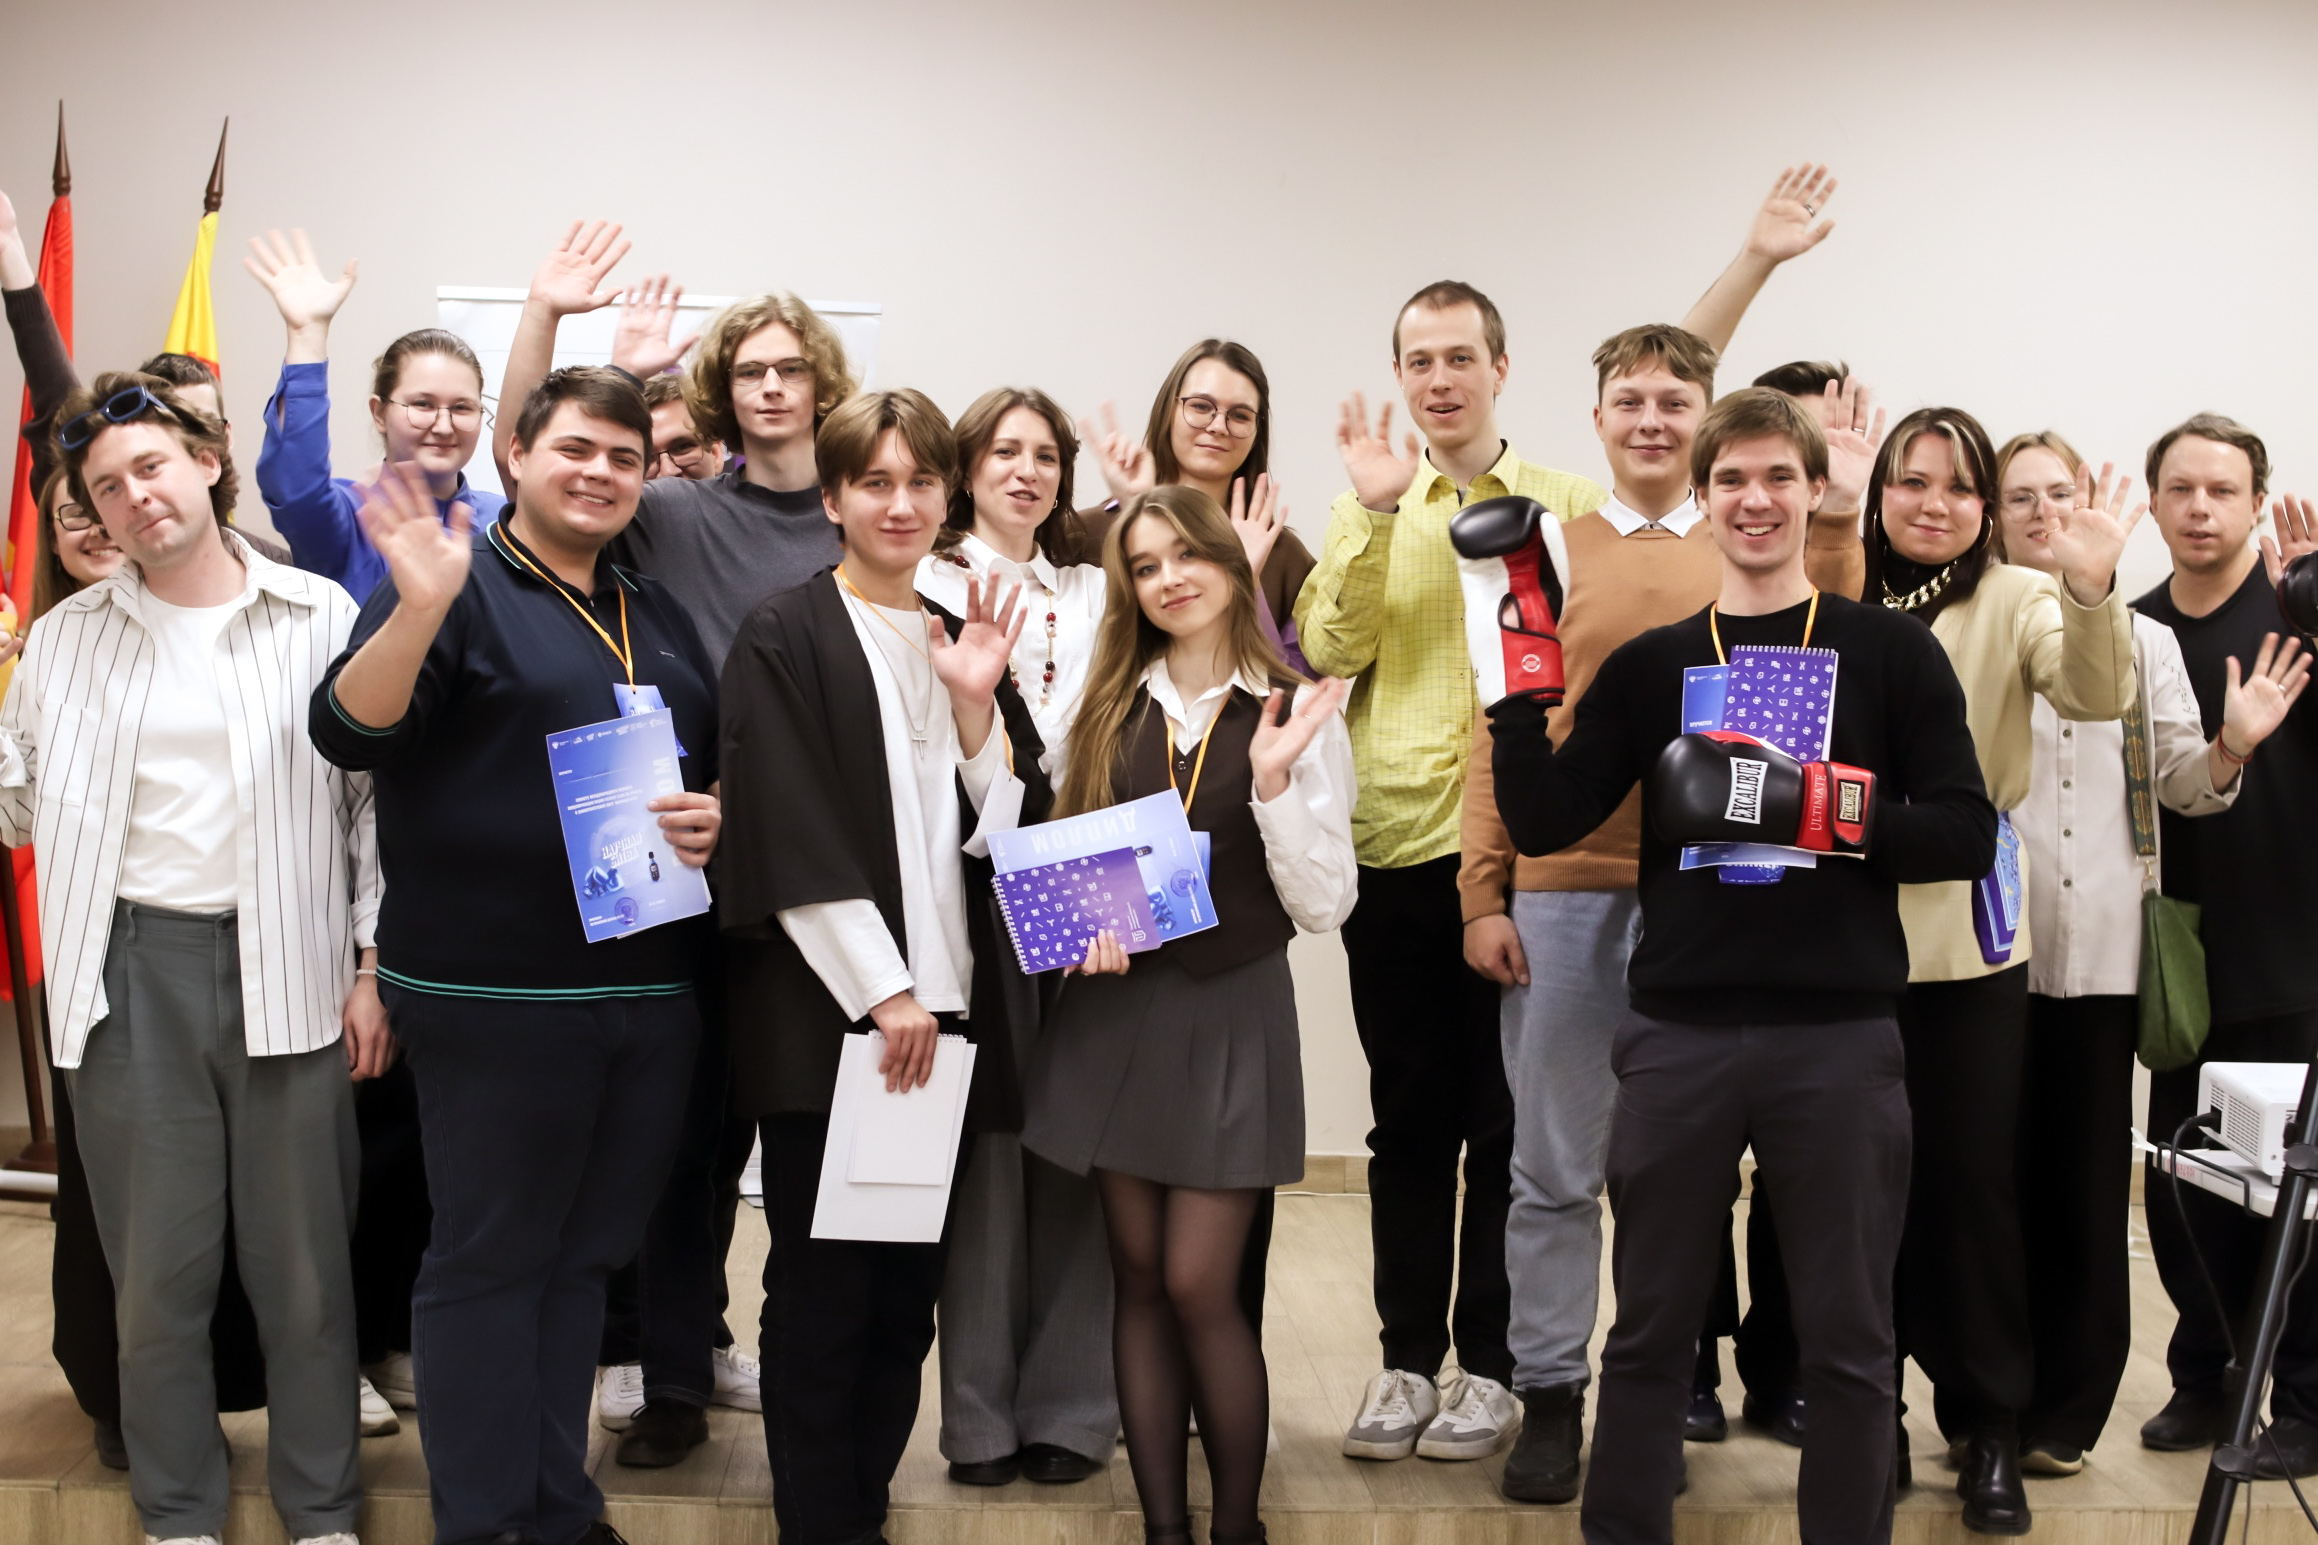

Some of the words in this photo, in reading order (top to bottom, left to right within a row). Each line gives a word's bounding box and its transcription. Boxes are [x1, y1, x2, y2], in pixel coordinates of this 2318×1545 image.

[1731, 762, 1762, 820] EXCALIBUR
[1811, 774, 1827, 831] ULTIMATE
[1031, 806, 1136, 854] ДИПЛОМ
